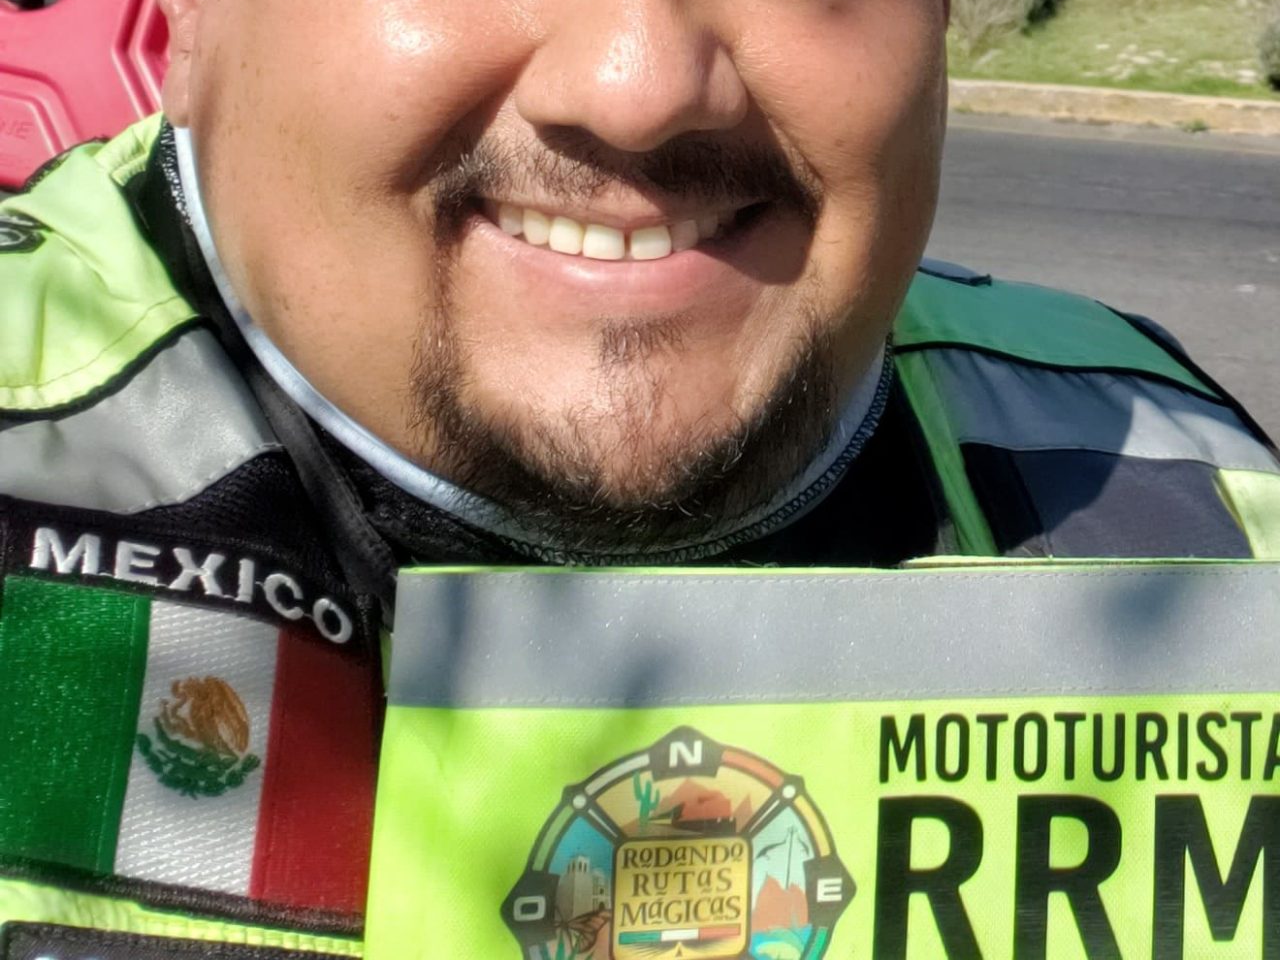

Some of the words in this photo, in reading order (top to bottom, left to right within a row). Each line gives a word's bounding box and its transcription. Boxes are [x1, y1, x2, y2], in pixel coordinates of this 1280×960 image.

[29, 527, 353, 644] MEXICO
[668, 740, 702, 768] N
[816, 878, 842, 902] E
[513, 896, 547, 921] O
